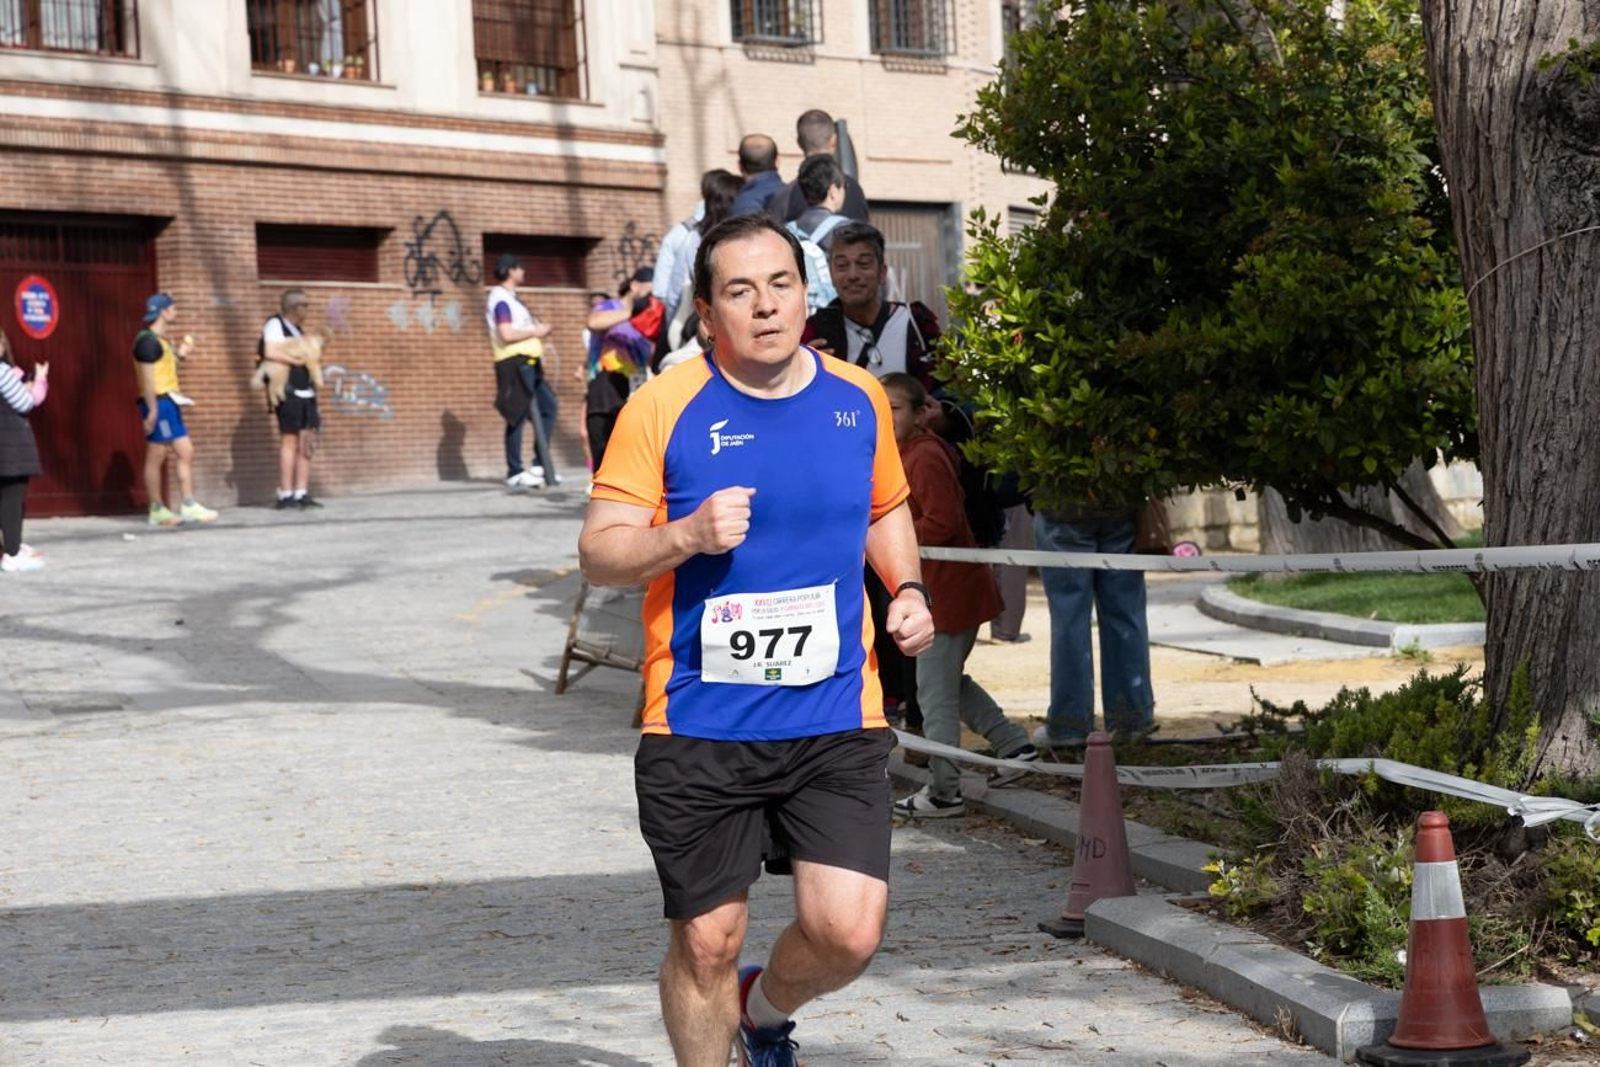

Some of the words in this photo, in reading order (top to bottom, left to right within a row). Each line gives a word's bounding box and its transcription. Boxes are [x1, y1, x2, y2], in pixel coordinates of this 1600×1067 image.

[721, 433, 755, 441] DIPUTACIÓN
[797, 592, 820, 602] POPULAR
[730, 625, 812, 660] 977
